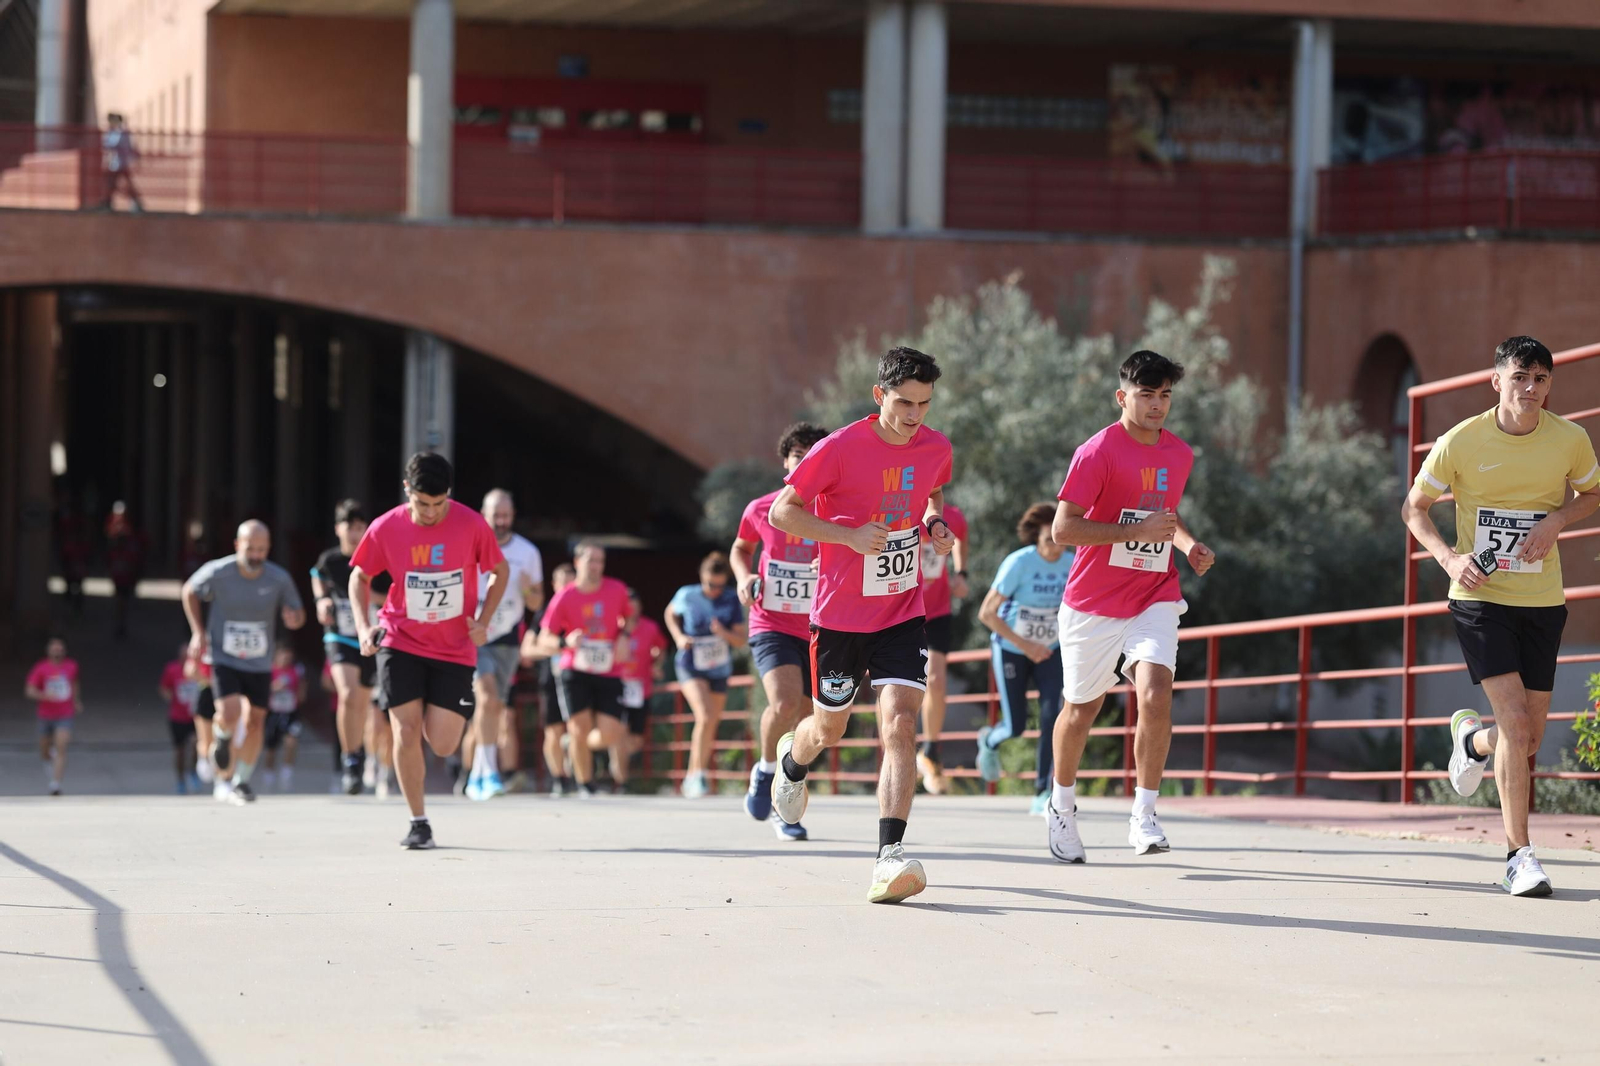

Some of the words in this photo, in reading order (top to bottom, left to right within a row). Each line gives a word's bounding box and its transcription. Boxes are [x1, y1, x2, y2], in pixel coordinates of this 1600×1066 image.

[882, 466, 914, 492] WE
[1140, 467, 1169, 491] WE
[1480, 517, 1512, 528] UMA
[411, 543, 444, 566] WE
[876, 550, 914, 578] 302
[423, 589, 449, 608] 72
[774, 580, 812, 599] 161
[1024, 623, 1057, 639] 306
